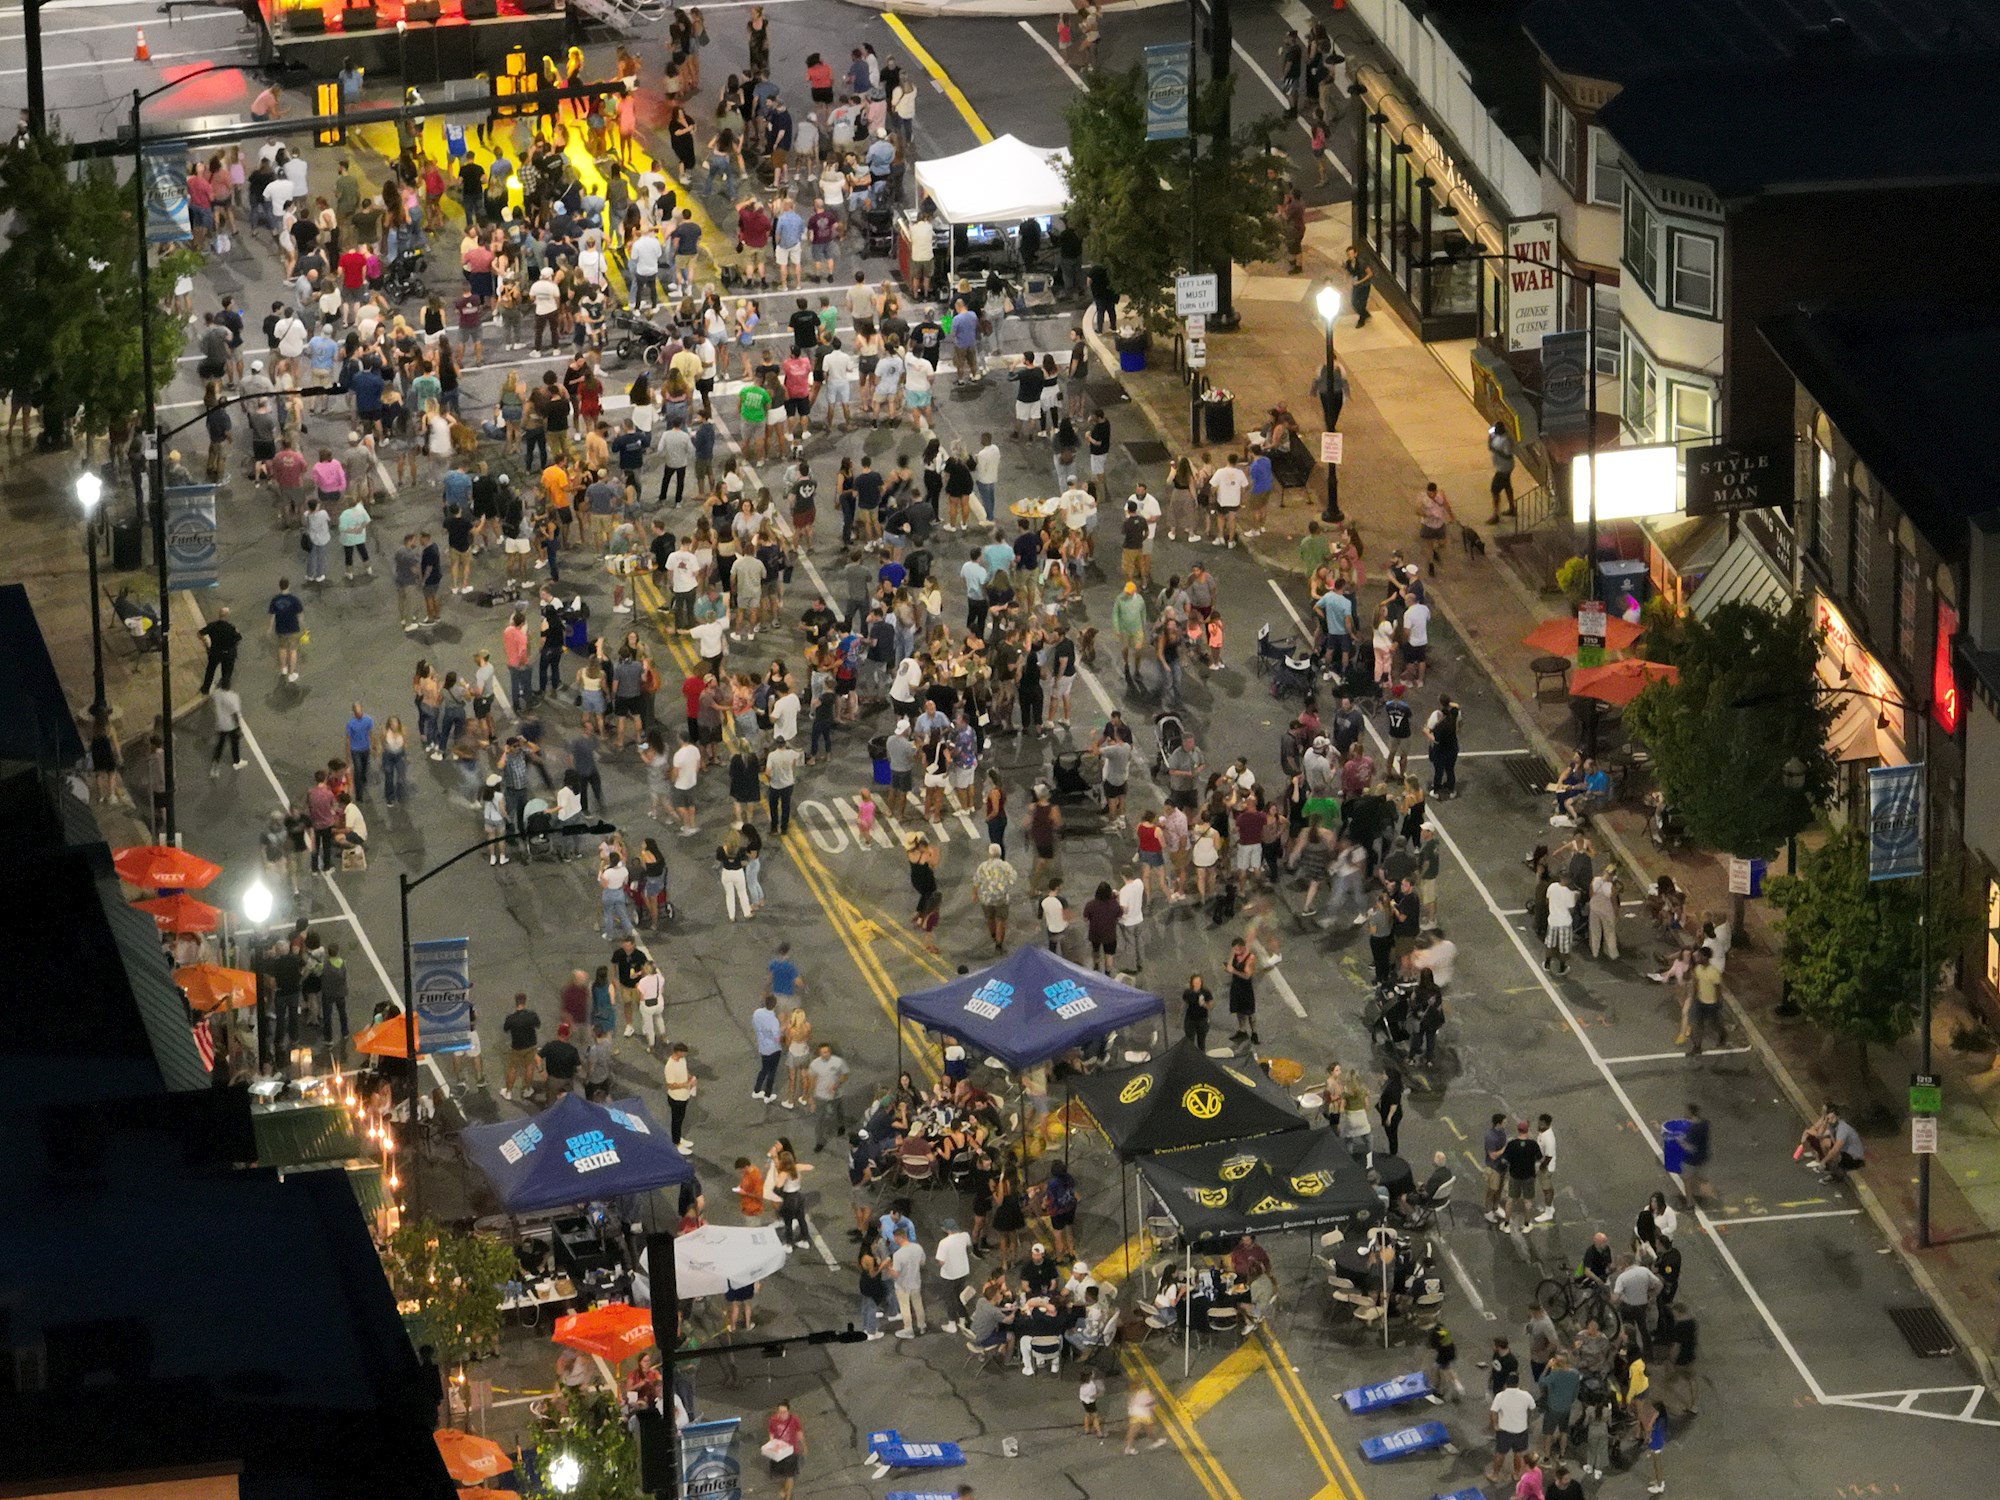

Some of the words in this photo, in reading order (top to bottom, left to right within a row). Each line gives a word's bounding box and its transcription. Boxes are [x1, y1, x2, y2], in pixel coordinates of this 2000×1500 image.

[1513, 240, 1551, 264] WIN
[1179, 280, 1194, 289] LEFT
[1197, 278, 1213, 287] LANE
[1511, 269, 1554, 293] WAH
[1186, 290, 1207, 299] MUST
[1179, 302, 1196, 310] TURN
[1199, 300, 1214, 309] LEFT
[1515, 305, 1549, 318] CHINESE
[1515, 320, 1549, 334] CUISINE
[1700, 456, 1769, 474] STYLE
[1723, 472, 1750, 486] OF
[1714, 486, 1758, 502] MAN
[1776, 526, 1790, 556] TALK
[1390, 714, 1403, 728] 17
[152, 873, 185, 881] VIZZY
[420, 991, 466, 1003] Funfest
[984, 978, 1014, 997] BUD
[1043, 978, 1077, 997] BUD
[972, 987, 1013, 1009] LIGHT
[1045, 987, 1088, 1010] LIGHT
[963, 998, 1001, 1020] SELTZER
[1056, 997, 1098, 1020] SELTZER
[1189, 1091, 1220, 1116] EVO
[566, 1130, 605, 1149] BUD
[564, 1138, 616, 1163] LIGHT
[574, 1150, 621, 1173] SELTZER
[687, 1477, 738, 1495] Funfest
